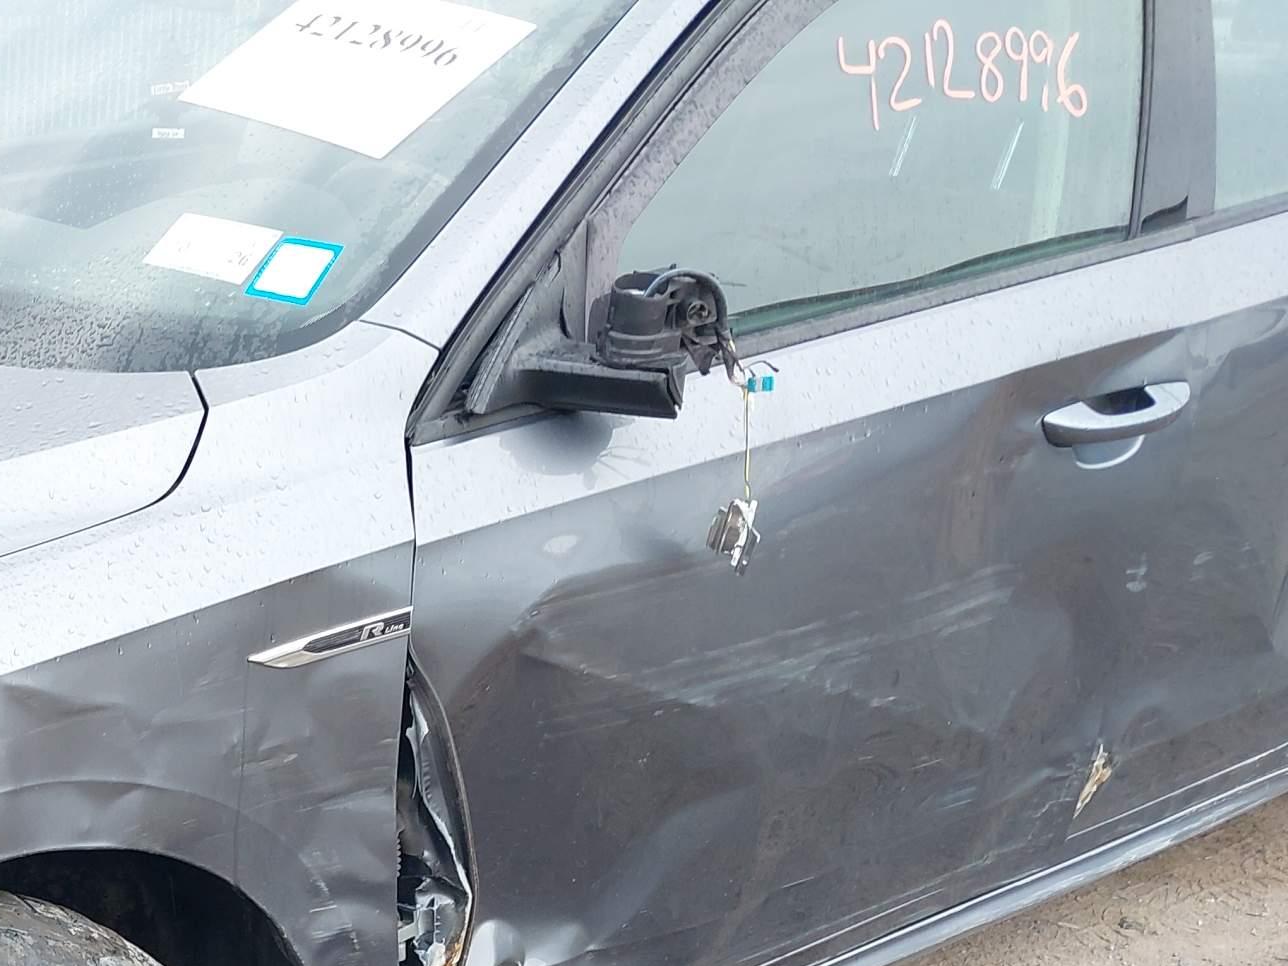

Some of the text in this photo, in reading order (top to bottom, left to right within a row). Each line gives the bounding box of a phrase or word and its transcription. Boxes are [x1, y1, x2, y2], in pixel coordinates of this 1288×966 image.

[295, 13, 458, 66] 42128996
[837, 18, 1088, 131] 42128996
[359, 621, 385, 642] R
